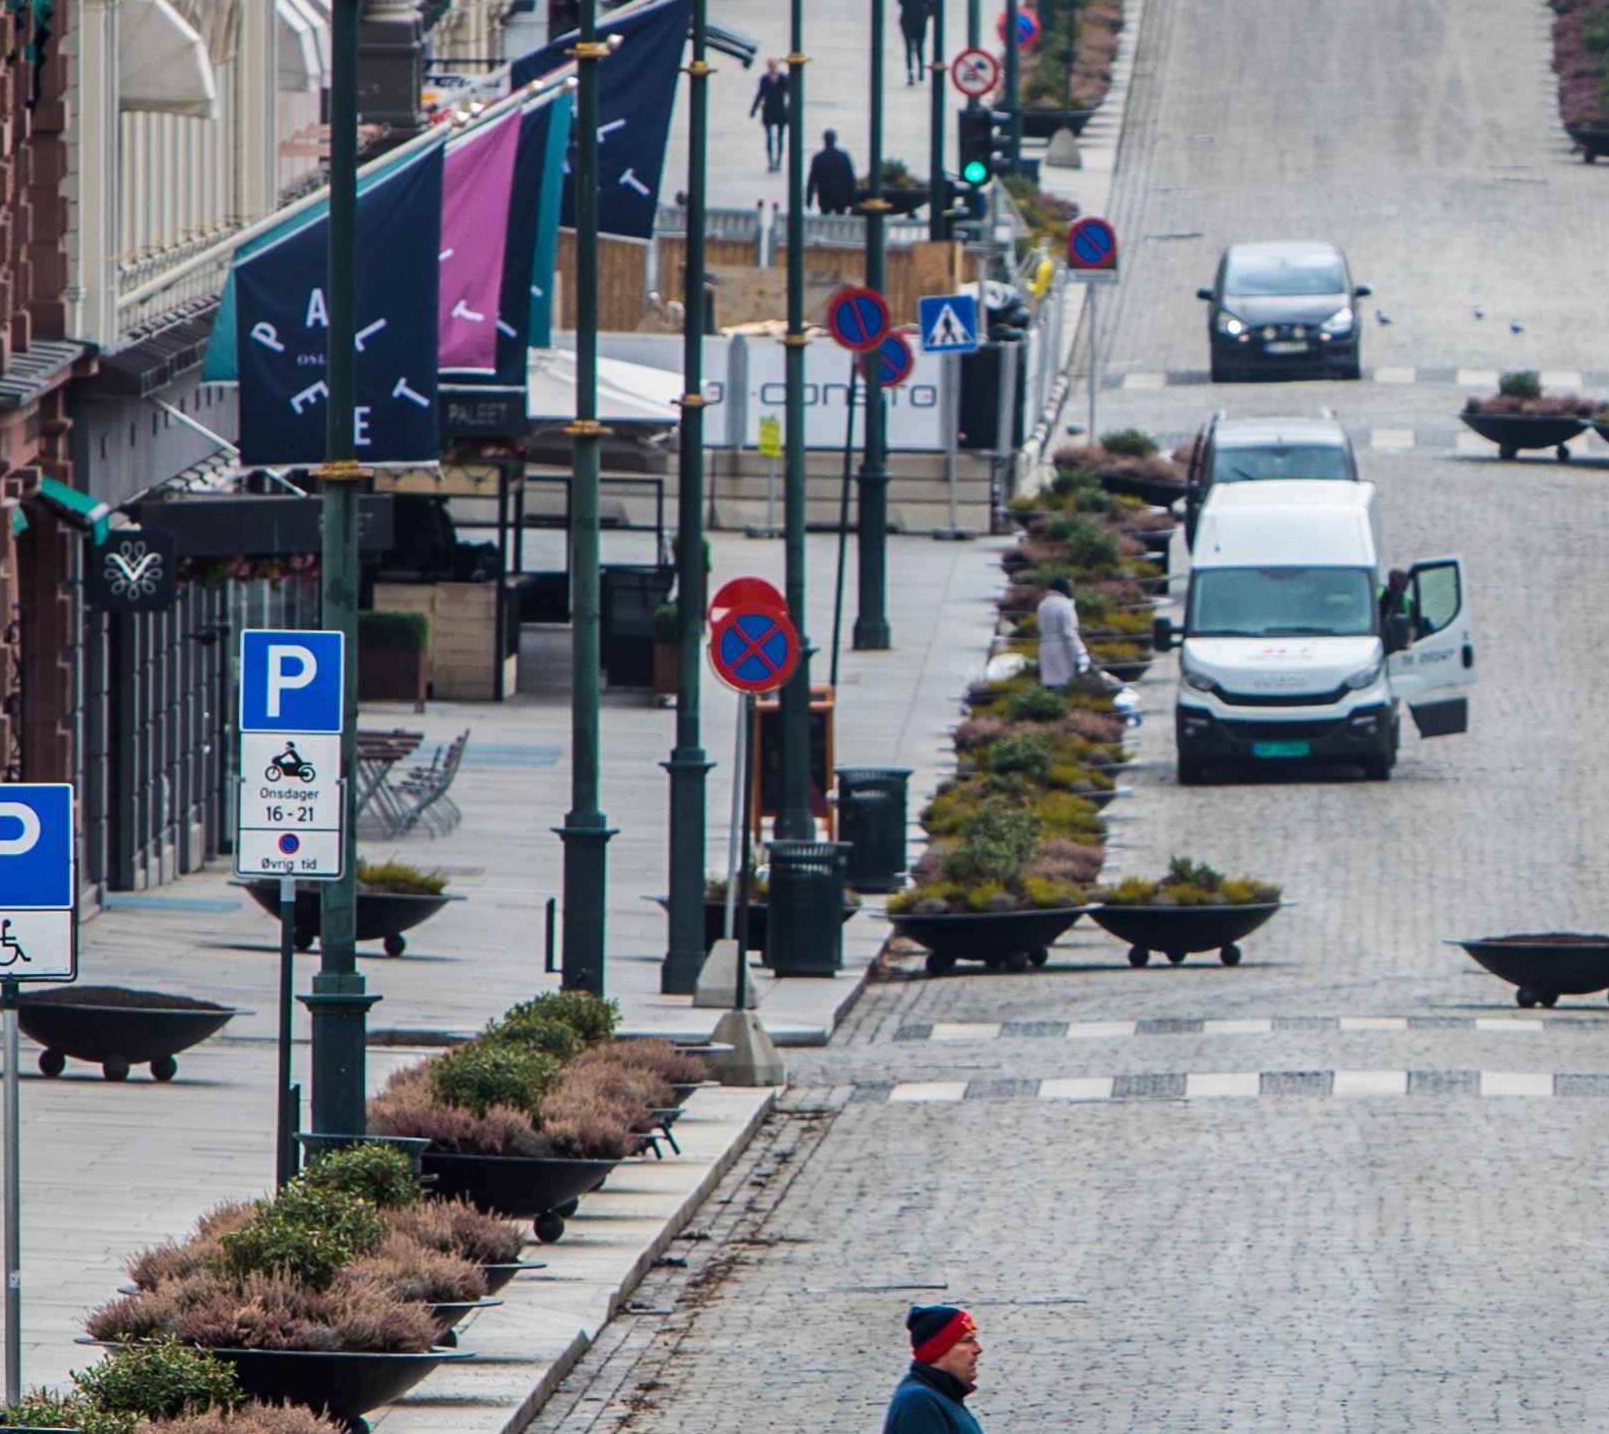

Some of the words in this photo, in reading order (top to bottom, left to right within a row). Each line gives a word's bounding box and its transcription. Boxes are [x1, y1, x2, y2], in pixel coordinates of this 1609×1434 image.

[296, 352, 328, 365] OSL
[448, 402, 508, 425] PALEET
[267, 644, 318, 718] P
[259, 787, 320, 802] Onsdager
[266, 806, 283, 822] 16
[297, 806, 314, 822] 21
[261, 857, 295, 872] Øvrig
[301, 858, 318, 870] tid
